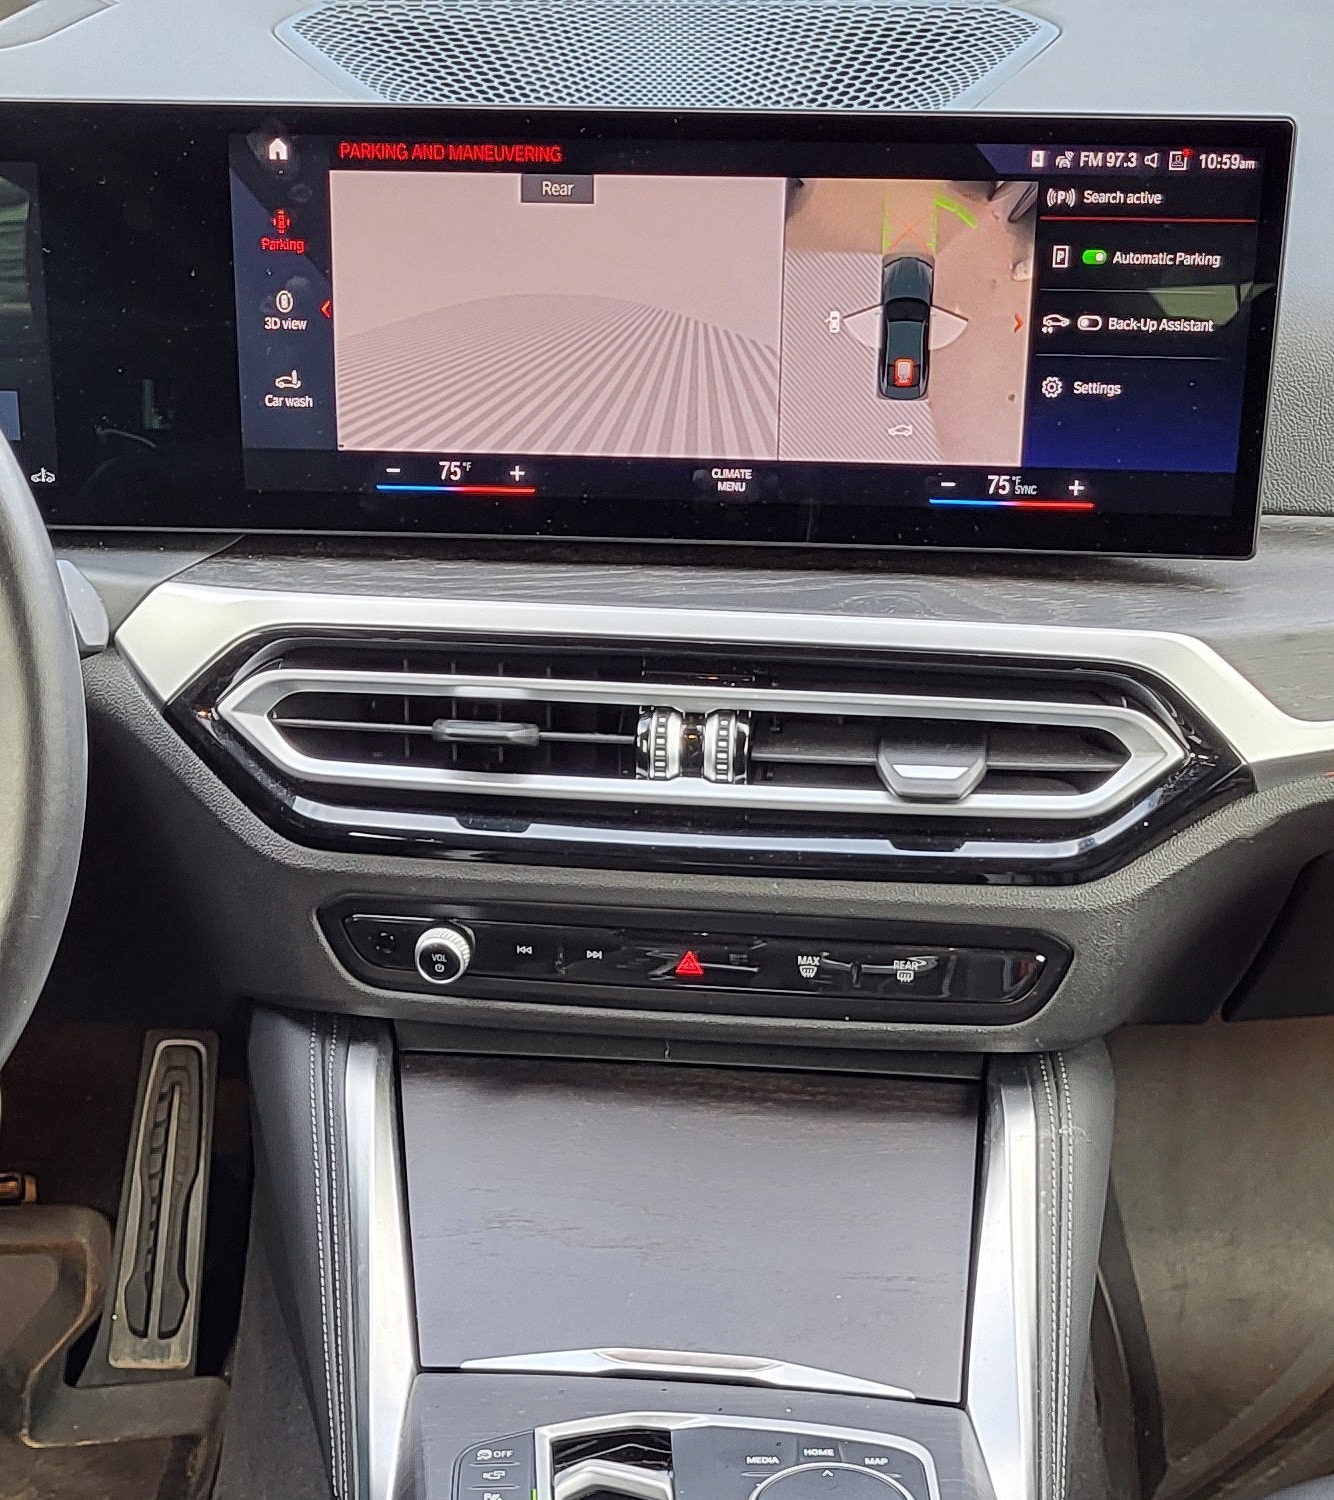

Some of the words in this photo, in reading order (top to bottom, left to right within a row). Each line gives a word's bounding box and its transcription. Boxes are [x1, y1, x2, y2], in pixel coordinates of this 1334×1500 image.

[339, 143, 408, 161] PARKING
[412, 144, 445, 161] AND
[448, 144, 563, 163] MANEUVERING
[1080, 152, 1103, 168] FM
[1106, 152, 1137, 168] 97.3
[542, 181, 575, 196] Rear
[1084, 190, 1124, 204] Search
[1127, 191, 1162, 205] active
[260, 238, 306, 254] Parking
[1113, 251, 1174, 265] Automatic
[1175, 252, 1222, 268] Parking
[264, 317, 280, 330] 3D
[281, 318, 308, 331] view
[1108, 317, 1158, 333] Back-Up
[1159, 318, 1214, 332] Assistant
[1073, 381, 1122, 397] Settings
[265, 394, 284, 407] Car
[285, 395, 314, 408] wash
[711, 468, 753, 480] CLIMATE
[717, 481, 746, 492] MENU
[1015, 485, 1037, 495] SYNC
[431, 954, 447, 963] VOL
[797, 955, 819, 966] MAX
[893, 960, 918, 971] REAR
[492, 1450, 514, 1459] OFF
[803, 1448, 835, 1457] HOME
[746, 1456, 780, 1465] MEDIA
[864, 1457, 889, 1466] MAP
